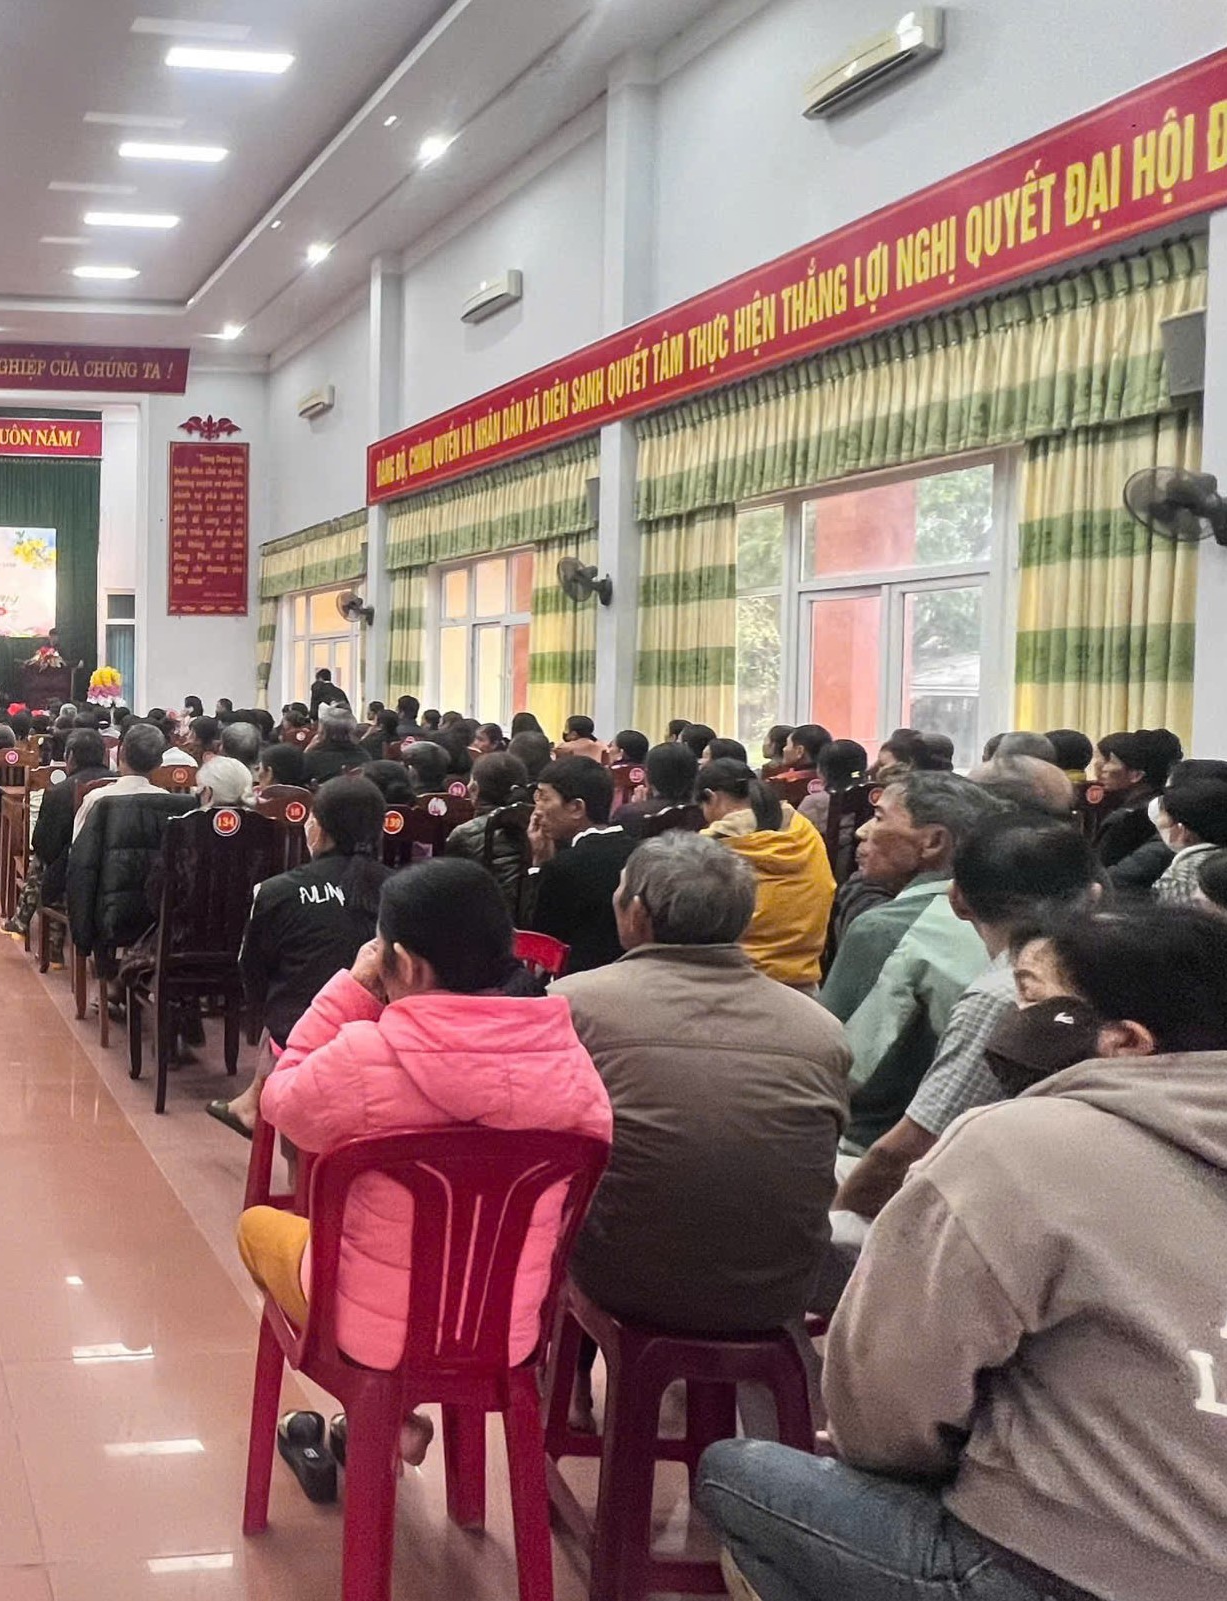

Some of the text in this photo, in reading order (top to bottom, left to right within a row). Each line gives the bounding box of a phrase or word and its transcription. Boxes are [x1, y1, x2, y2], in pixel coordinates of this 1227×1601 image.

[502, 398, 523, 441] DÂN
[525, 387, 540, 433] XÃ
[542, 378, 569, 426] DIÊN
[572, 367, 604, 415] SANH
[607, 337, 649, 405] QUYẾT
[652, 331, 684, 385] TÂM
[688, 313, 729, 373] THỰC
[734, 290, 775, 356] HIỆN
[781, 257, 847, 335] THẮNG
[854, 241, 888, 313] LỢI
[896, 215, 956, 284] NGHỊ
[965, 158, 1057, 269] QUYẾT
[1064, 143, 1121, 230] ĐẠI
[1132, 106, 1195, 204] HỘI
[50, 352, 80, 377] CỦA
[83, 356, 138, 379] CHÚNG
[217, 816, 235, 827] 134
